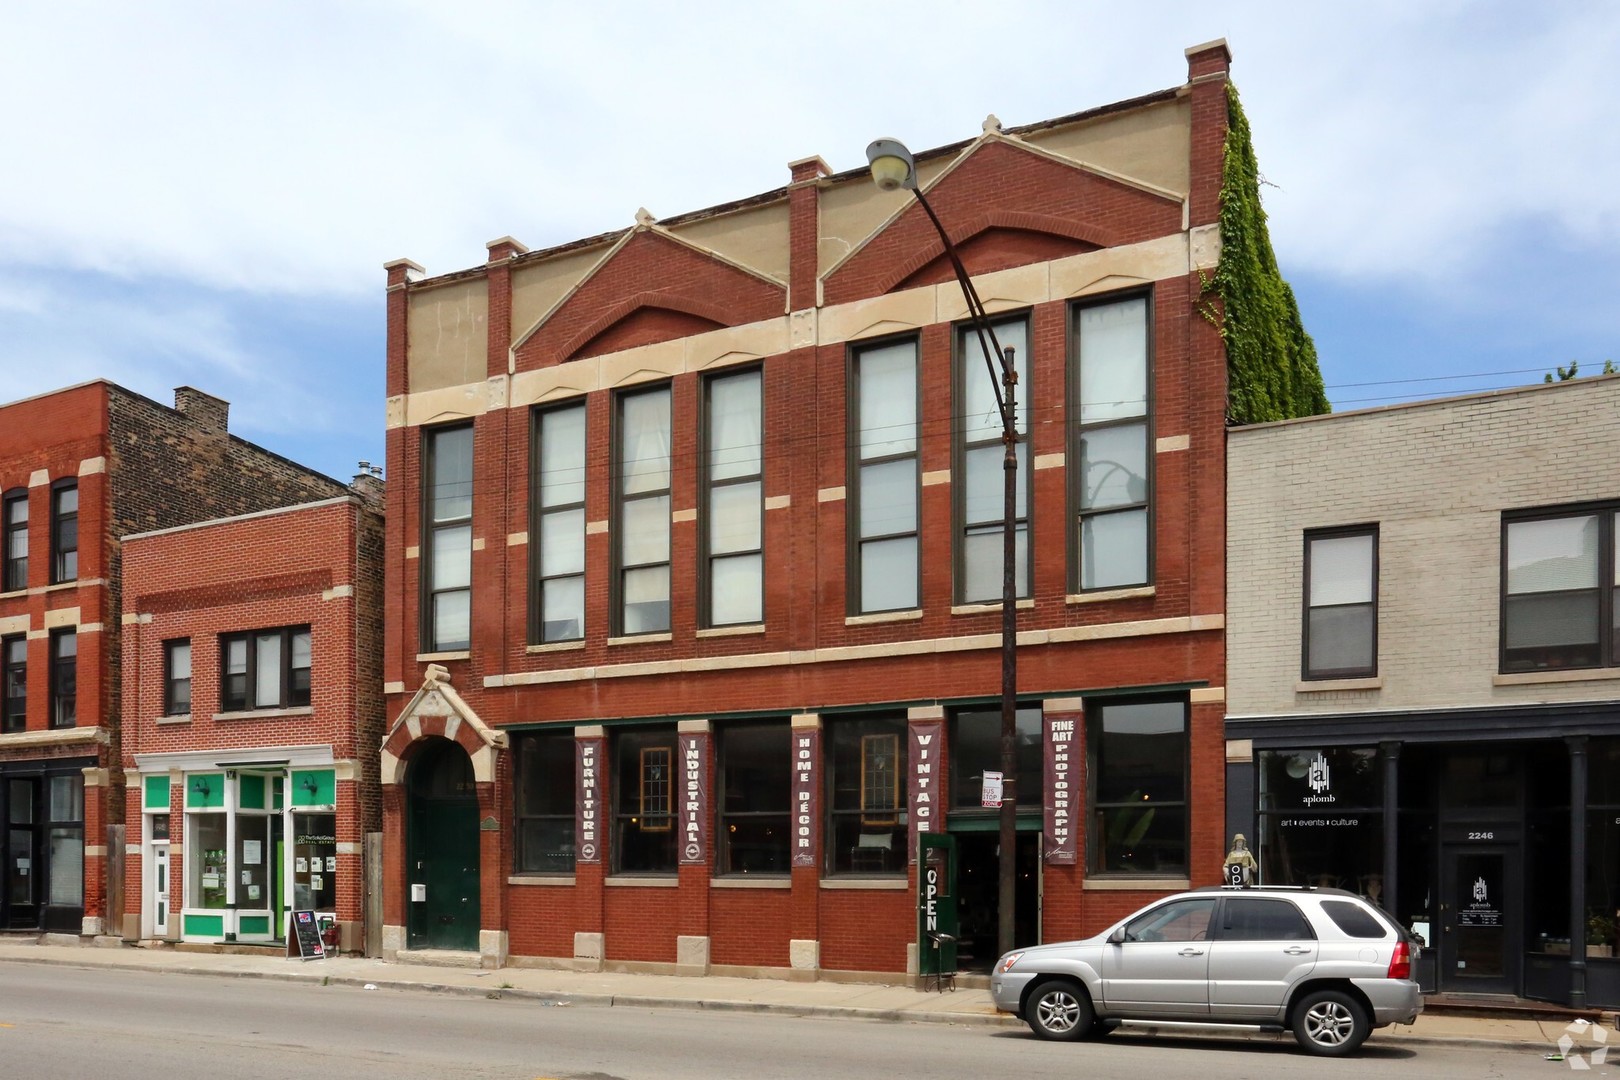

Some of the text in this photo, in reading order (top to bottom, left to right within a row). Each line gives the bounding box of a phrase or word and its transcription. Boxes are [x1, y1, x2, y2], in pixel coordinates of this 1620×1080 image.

[1051, 720, 1074, 731] FINE
[1052, 731, 1074, 742] ART
[797, 738, 812, 782] HOME
[916, 735, 932, 831] VINTAGE
[583, 747, 595, 840] FURNITURE
[686, 740, 699, 842] INDUSTRIAL
[1054, 744, 1068, 845] PHOTOGRAPHY
[1302, 794, 1336, 807] aplomb
[798, 791, 810, 847] DÉCOR
[1280, 818, 1358, 827] art events culture
[1468, 832, 1494, 840] 2246
[926, 869, 938, 932] OPEN
